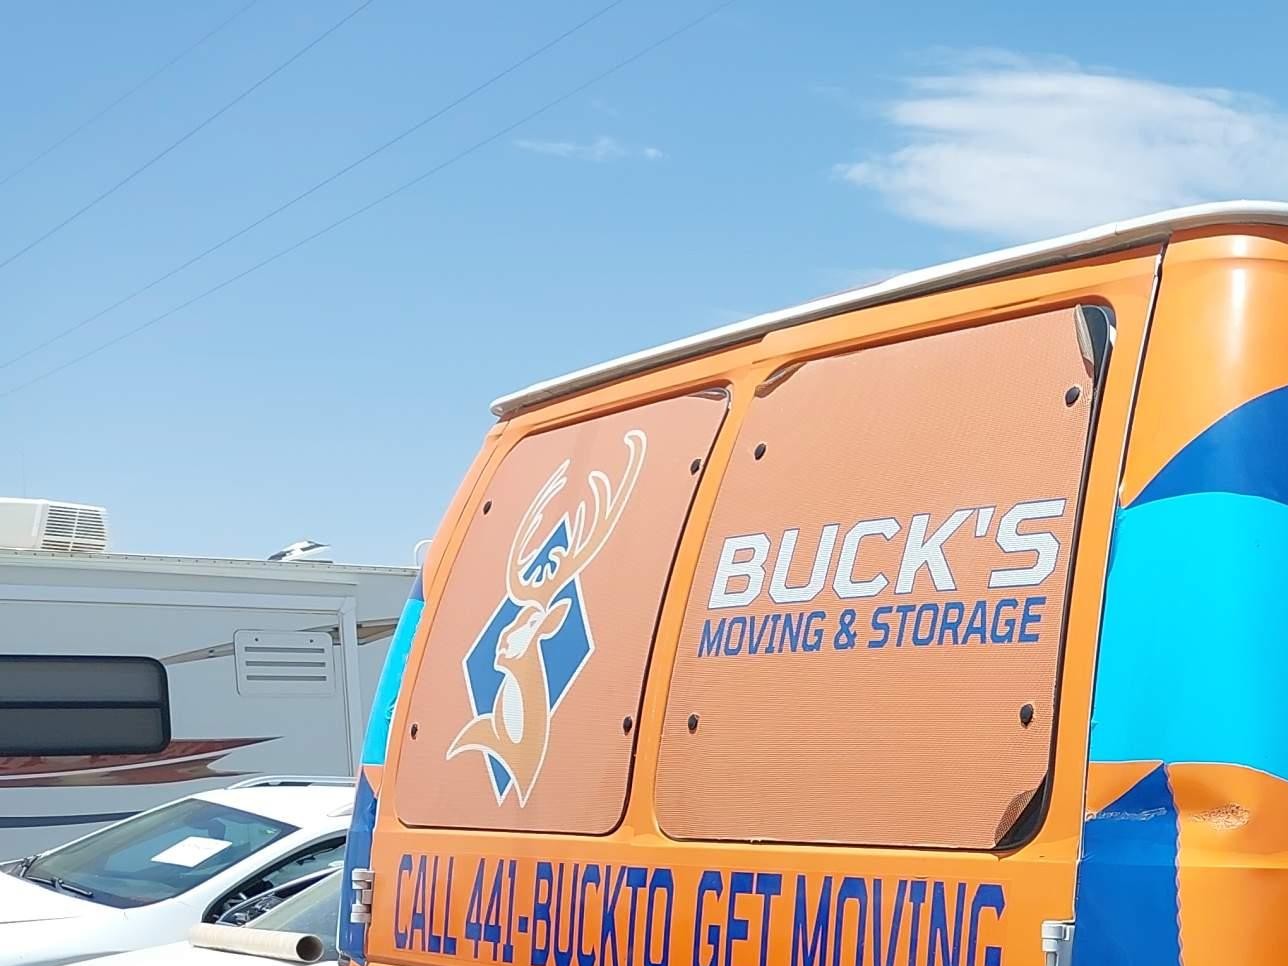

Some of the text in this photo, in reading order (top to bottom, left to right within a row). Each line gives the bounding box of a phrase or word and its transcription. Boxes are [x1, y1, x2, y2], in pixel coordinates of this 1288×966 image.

[707, 499, 1067, 610] BUCK'S
[697, 596, 1047, 657] MOVING & STORAGE
[393, 853, 456, 955] CALL
